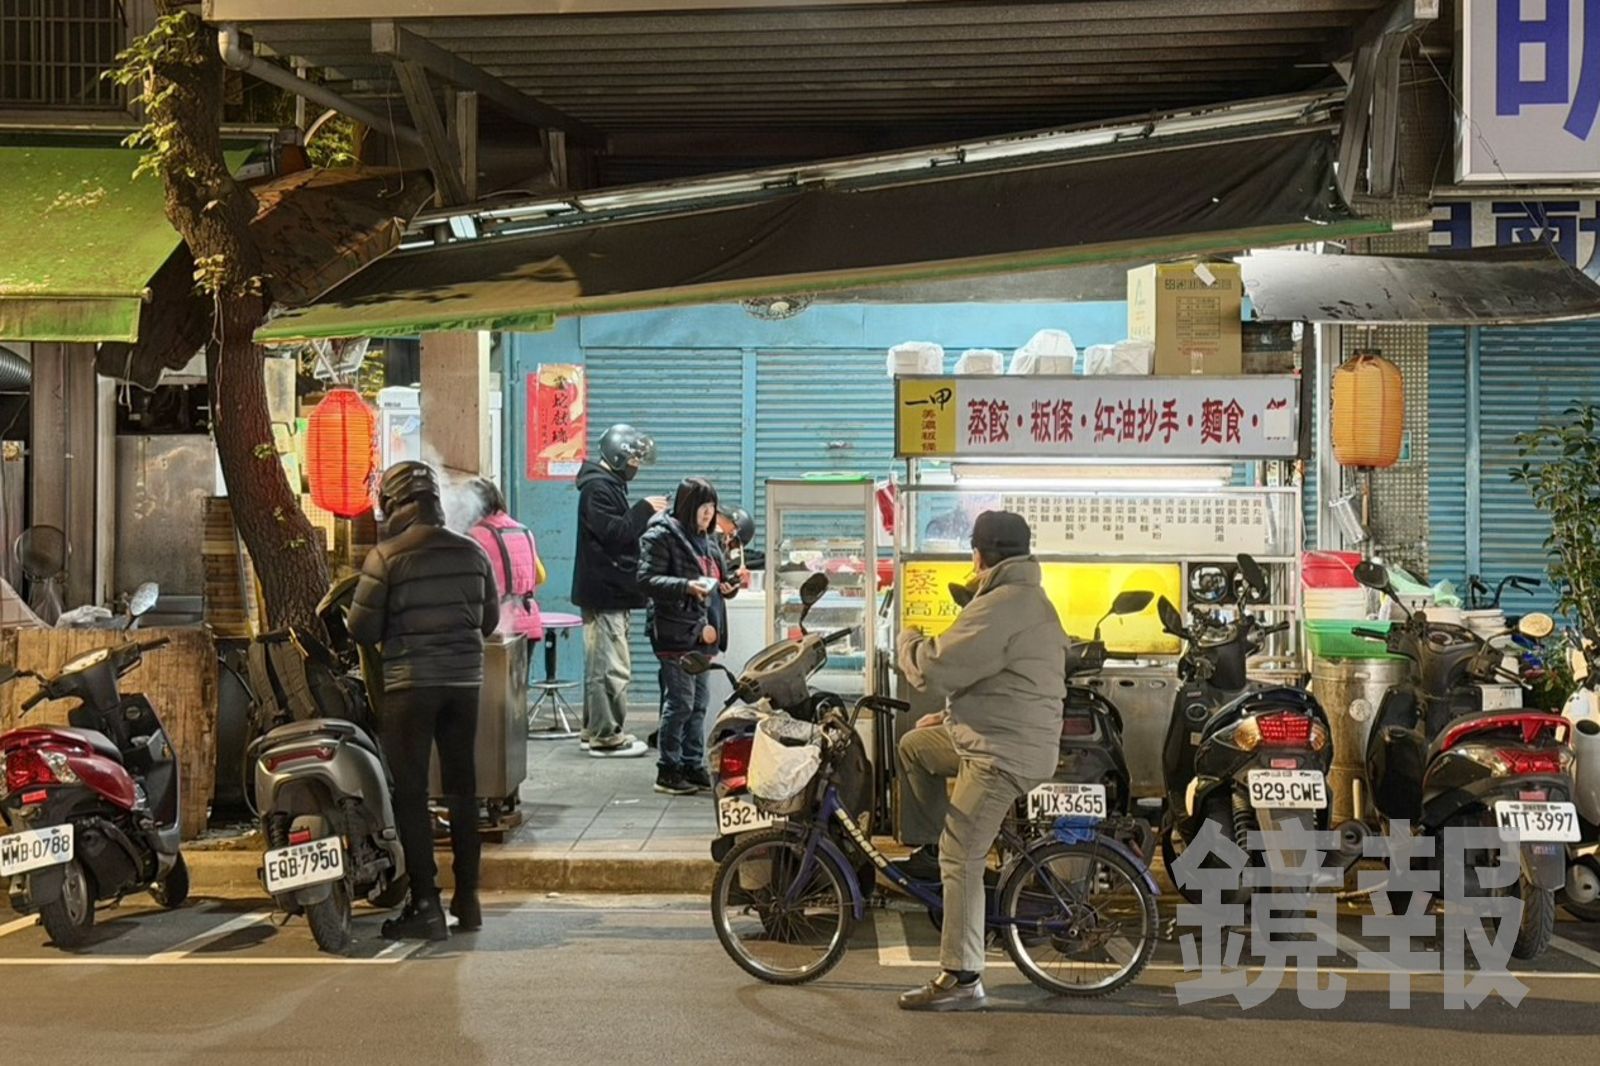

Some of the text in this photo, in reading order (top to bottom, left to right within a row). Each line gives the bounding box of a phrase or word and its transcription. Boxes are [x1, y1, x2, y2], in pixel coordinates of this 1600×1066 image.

[905, 388, 952, 411] 一甲
[1252, 782, 1324, 802] 929-CWE
[1031, 793, 1103, 815] MUX-3655
[722, 805, 788, 829] 532-N
[1499, 811, 1573, 832] MTT-3997
[268, 847, 340, 882] EQB-7950
